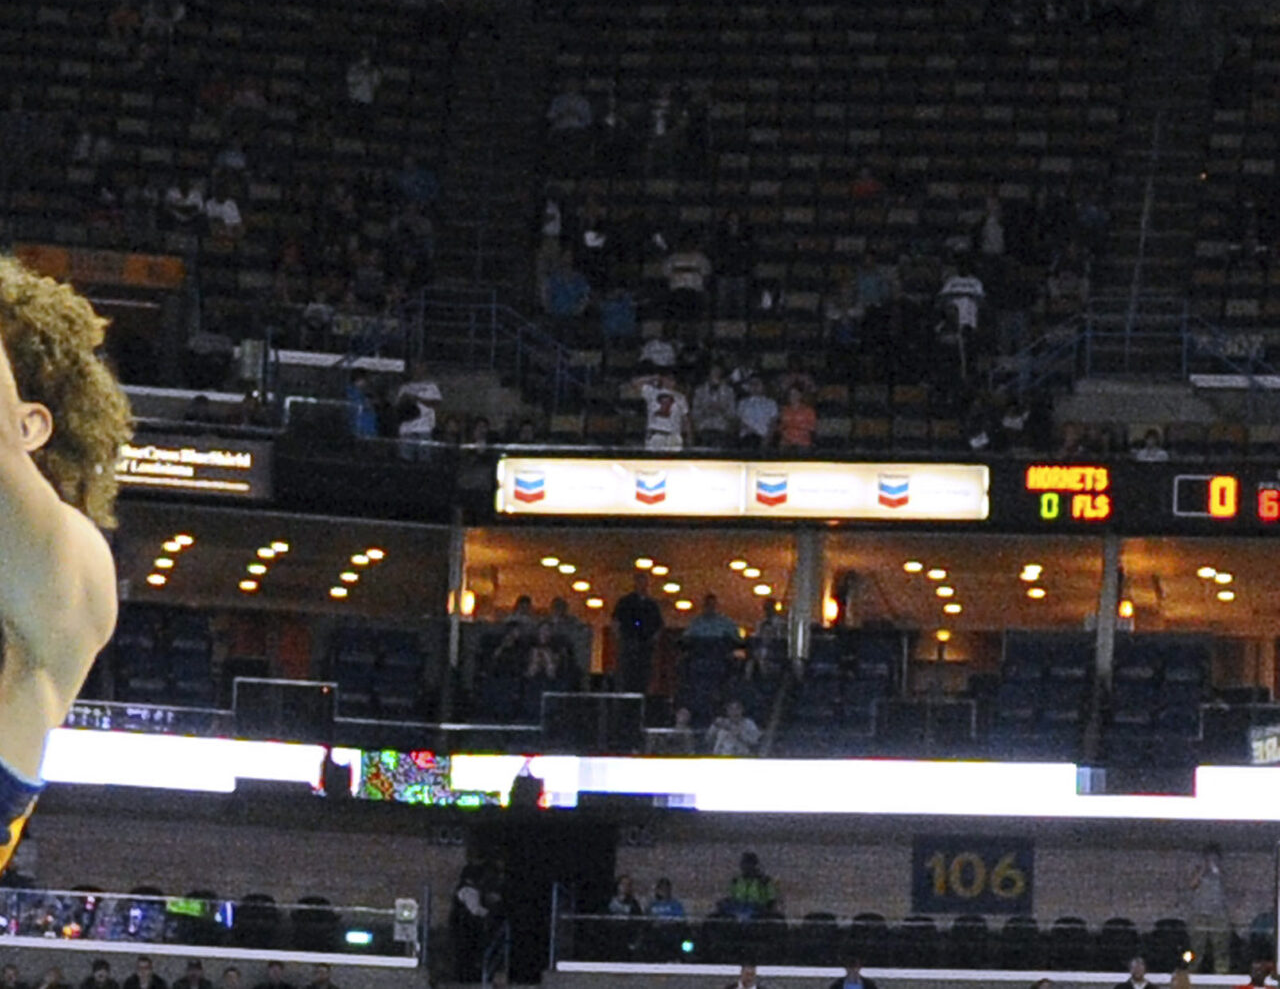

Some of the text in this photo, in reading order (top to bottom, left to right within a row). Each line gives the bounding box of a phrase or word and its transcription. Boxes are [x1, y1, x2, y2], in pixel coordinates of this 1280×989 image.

[1026, 466, 1108, 490] HORNETS
[1072, 494, 1110, 518] FLS
[1210, 475, 1237, 517] 0
[924, 852, 1026, 899] 106
